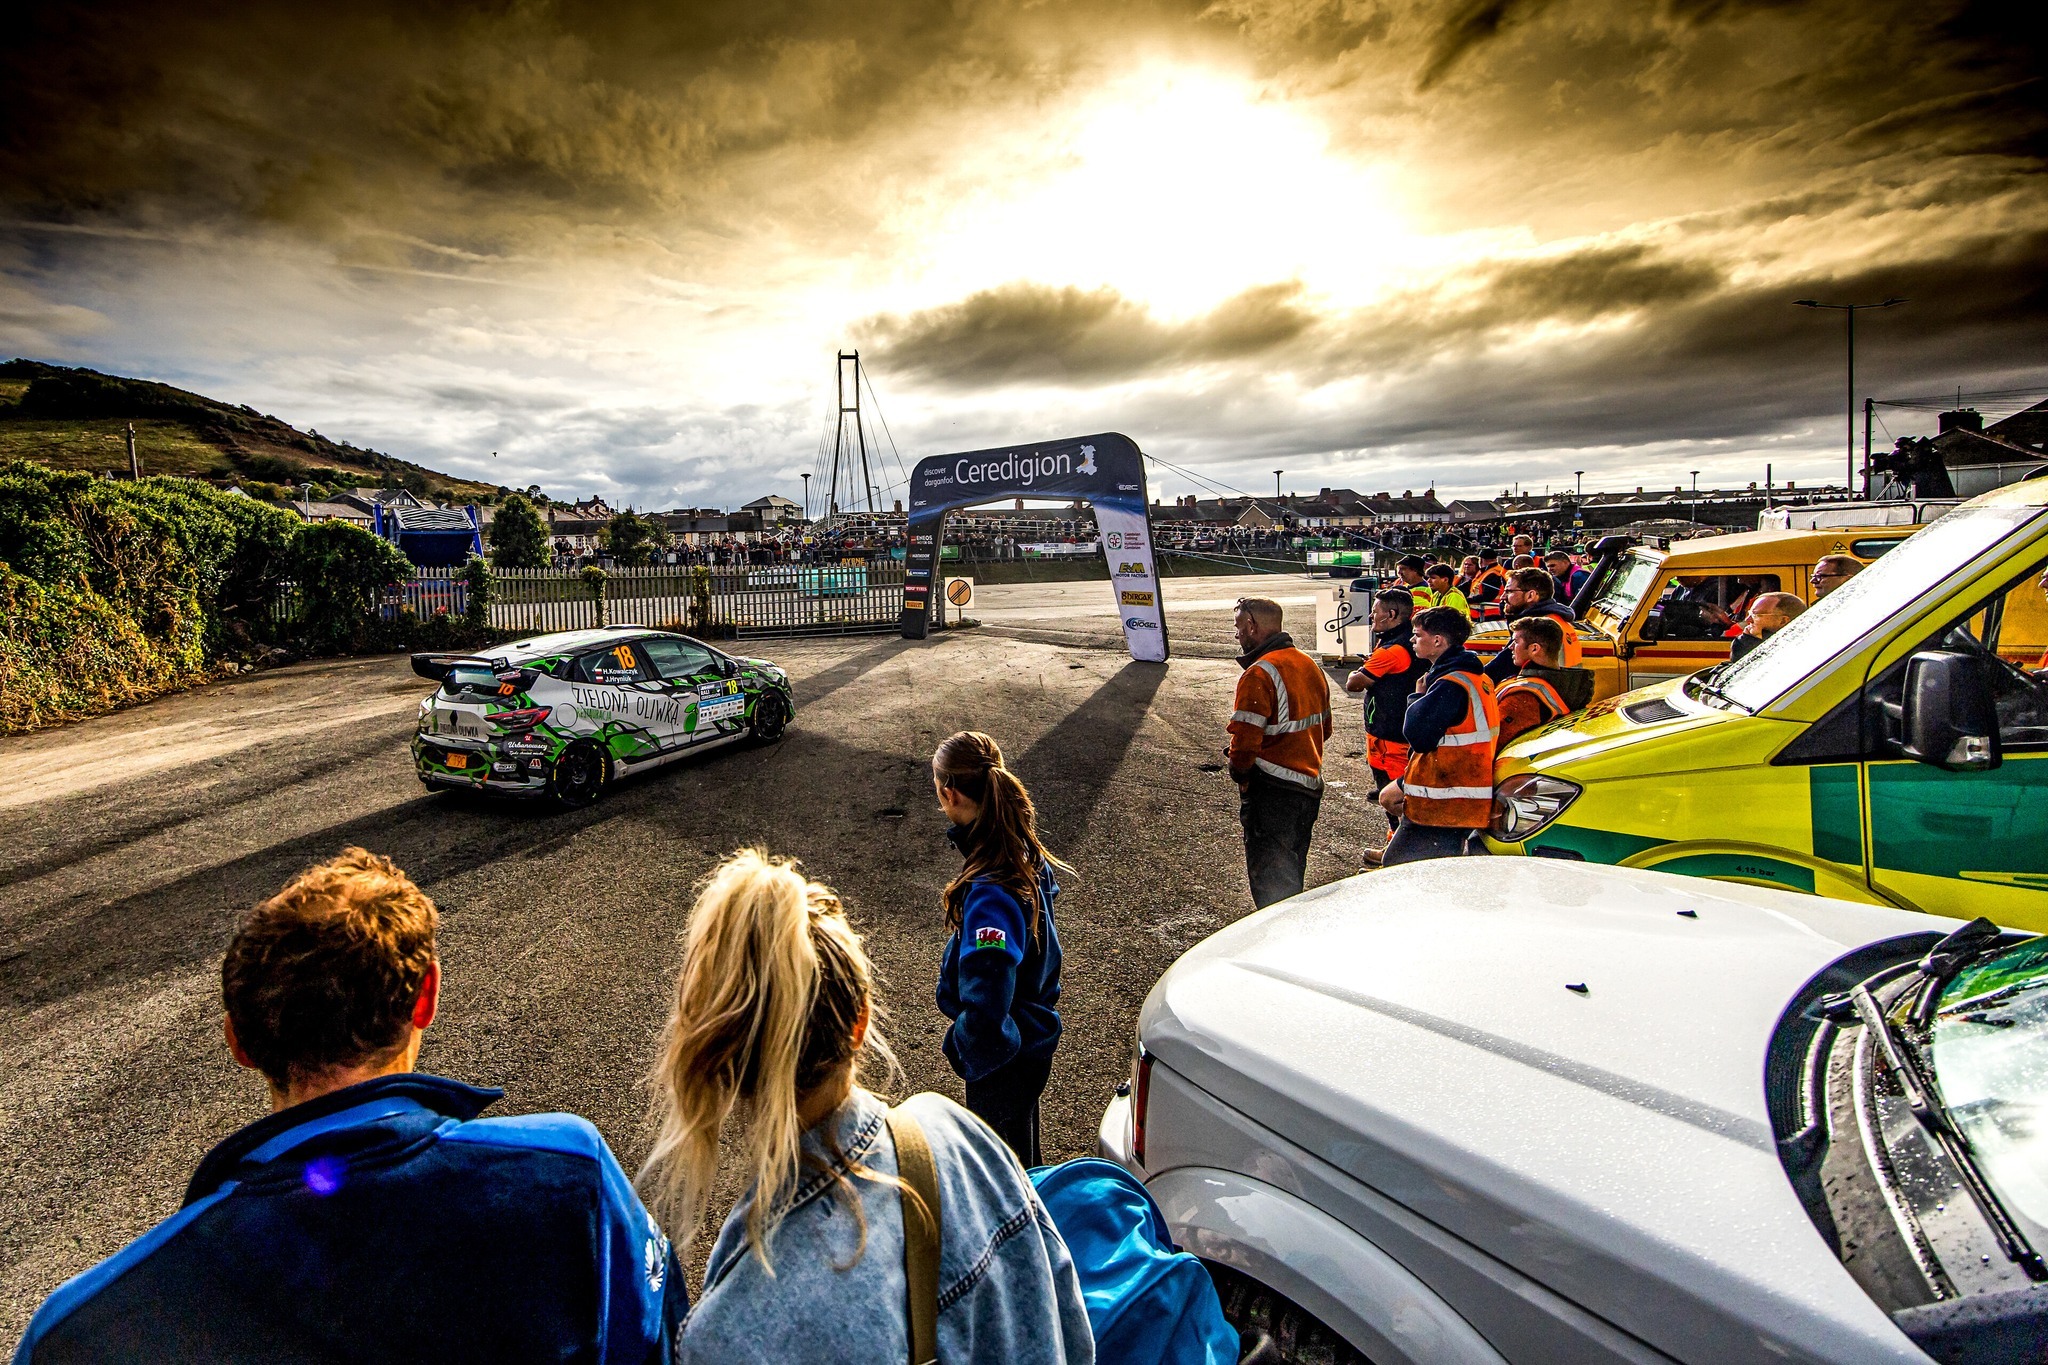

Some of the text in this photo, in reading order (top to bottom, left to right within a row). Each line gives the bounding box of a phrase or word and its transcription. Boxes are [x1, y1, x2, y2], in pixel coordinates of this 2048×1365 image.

[924, 467, 946, 476] discover
[955, 451, 1070, 486] Ceredigion
[924, 476, 954, 488] darganfod
[1119, 562, 1145, 573] E&M
[1338, 589, 1345, 598] 2
[612, 645, 636, 669] 18
[726, 680, 738, 694] 18
[572, 687, 628, 714] ZIELONA
[458, 726, 478, 737] OLIWKA
[1736, 865, 1756, 874] 4.15
